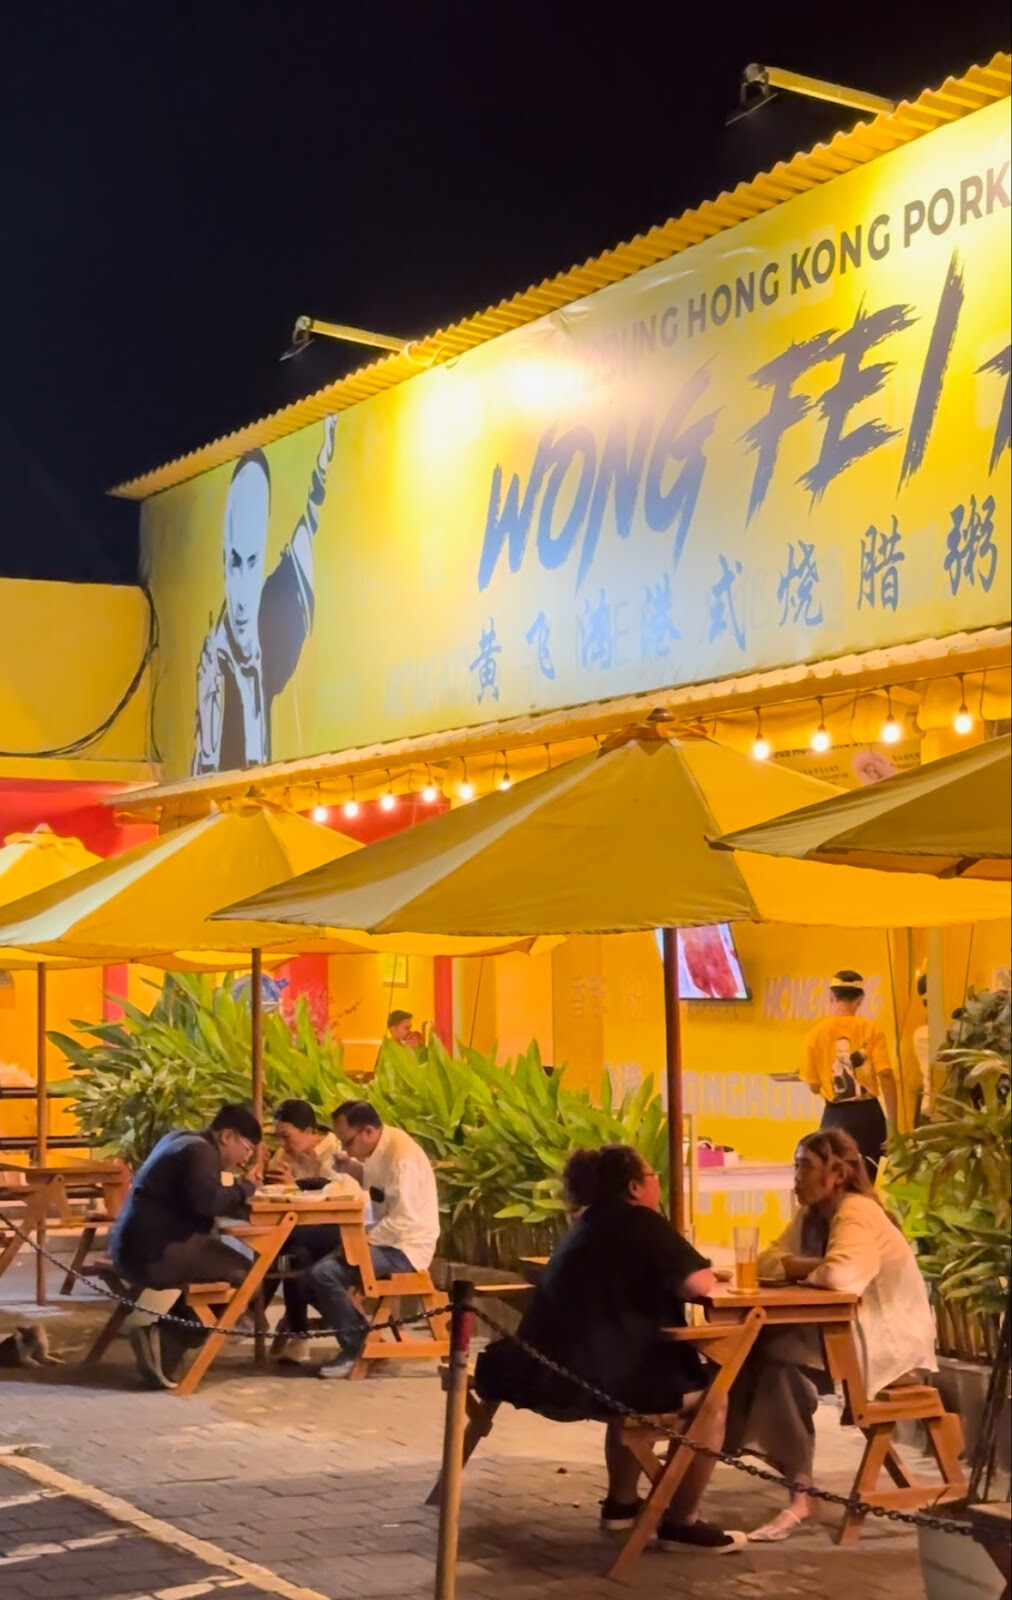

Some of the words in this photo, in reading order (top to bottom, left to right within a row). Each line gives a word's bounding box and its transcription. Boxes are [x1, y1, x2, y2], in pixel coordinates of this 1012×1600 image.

[687, 262, 780, 338] HONG
[790, 213, 890, 296] KONG
[904, 161, 1011, 248] PORK
[477, 353, 726, 598] WONG
[735, 246, 966, 533] FEI
